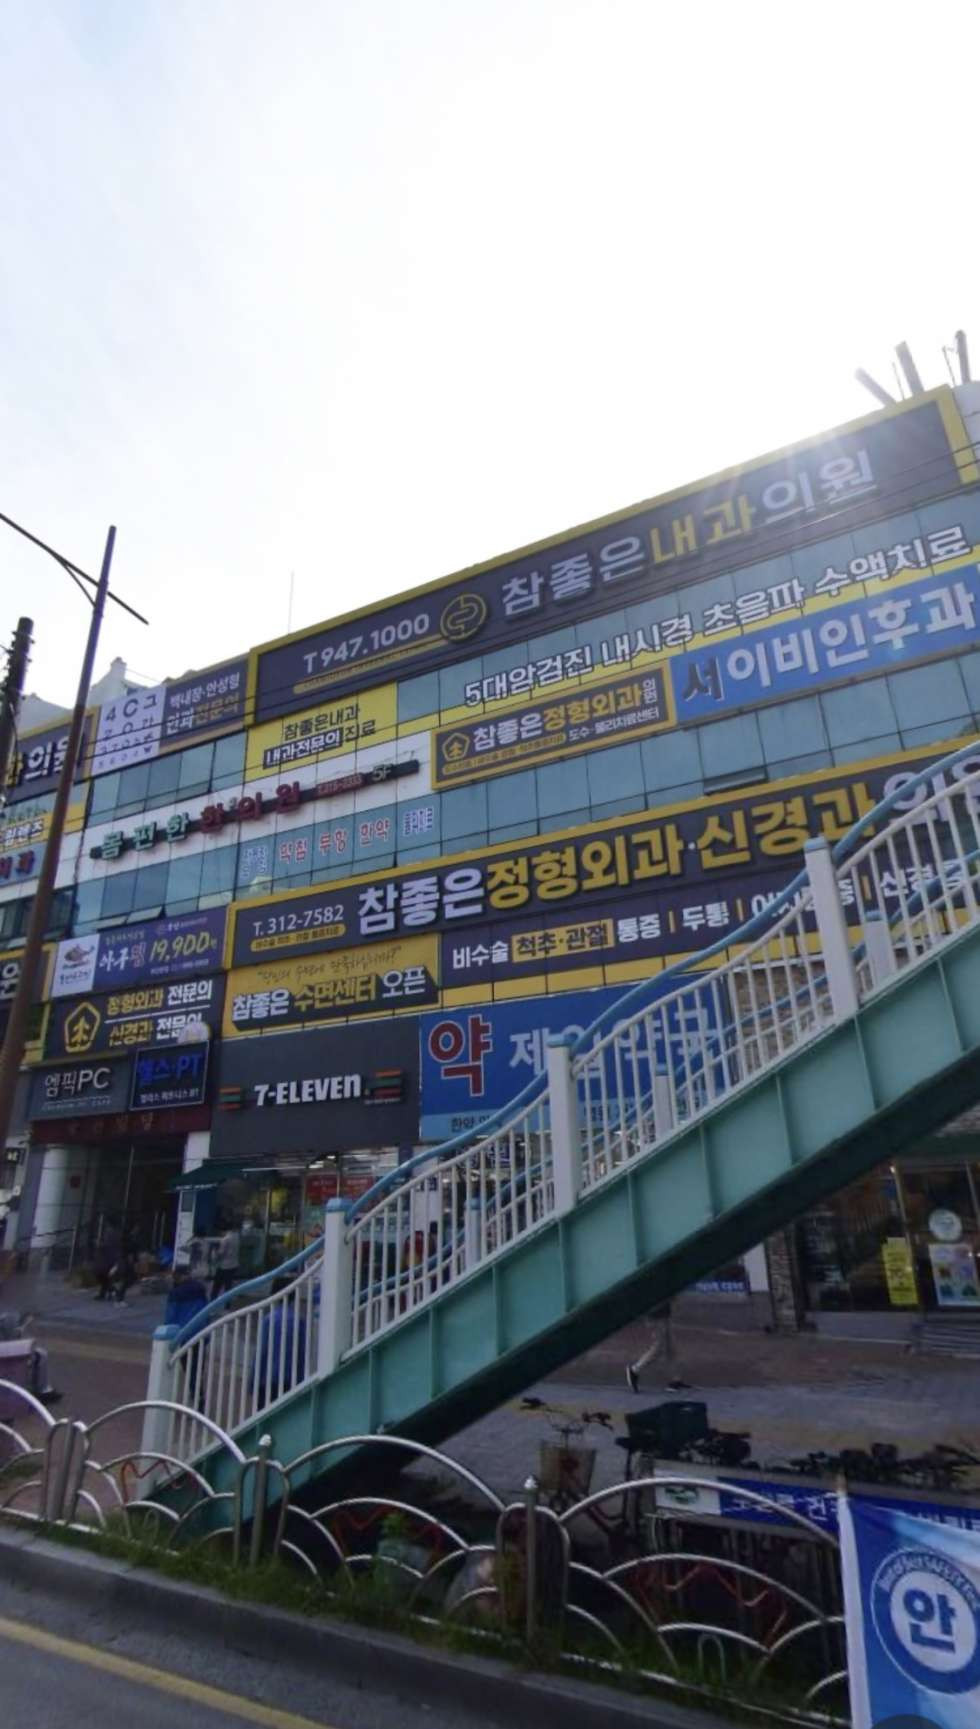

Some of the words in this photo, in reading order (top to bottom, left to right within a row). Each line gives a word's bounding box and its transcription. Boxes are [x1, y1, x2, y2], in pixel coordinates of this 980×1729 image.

[502, 450, 877, 616] 참좋은내과의원
[320, 613, 430, 667] 947.1000
[465, 649, 595, 706] 5대암검진
[602, 613, 693, 676] 내시경
[702, 580, 805, 637] 초음파
[816, 525, 971, 597] 수액치료
[683, 582, 976, 703] 서이비인후과
[265, 730, 341, 765] 내과전문의
[342, 719, 377, 743] 진료
[284, 703, 361, 742] 참좋은내과
[472, 684, 643, 752] 참좋은정형외과
[101, 810, 191, 861] 몸편한
[200, 780, 303, 836] 한의원
[267, 904, 345, 935] 312-7582
[452, 941, 510, 970] 비수술
[515, 920, 611, 958] 척추·관절
[617, 914, 661, 944] 통증
[682, 900, 730, 932] 두통
[167, 979, 213, 1006] 전문의
[232, 988, 289, 1022] 참좋은
[293, 973, 377, 1013] 수면센터
[382, 964, 427, 998] 오픈
[428, 1012, 493, 1098] 약
[902, 1588, 957, 1655] 안
